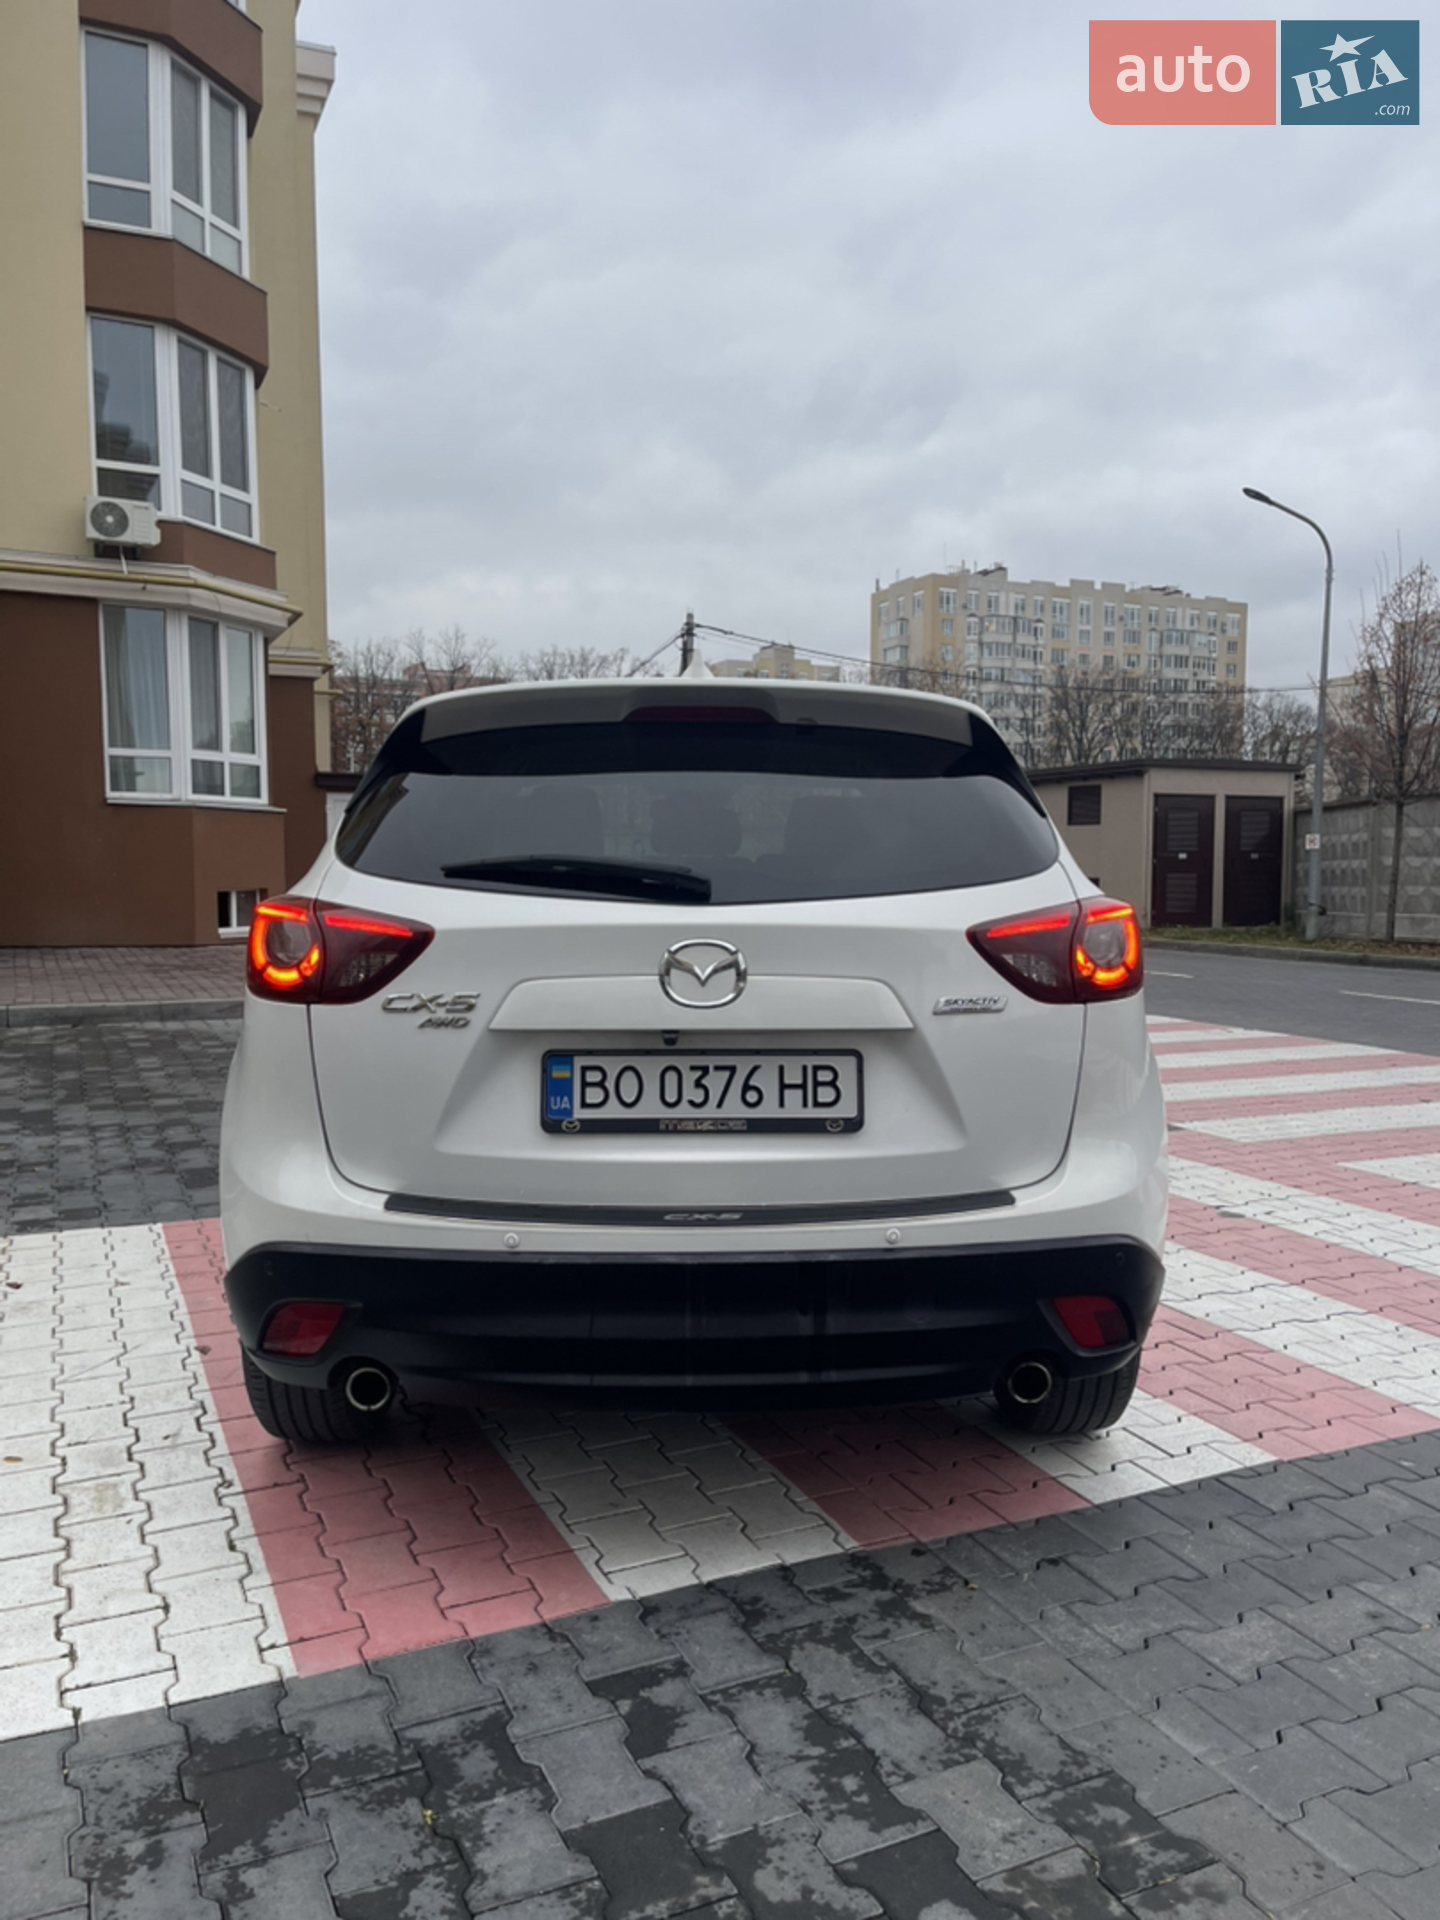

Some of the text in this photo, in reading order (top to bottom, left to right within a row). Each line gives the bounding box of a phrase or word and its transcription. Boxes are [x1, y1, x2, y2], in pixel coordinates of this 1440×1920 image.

[381, 992, 481, 1014] CX-5
[417, 1017, 471, 1029] AWD
[580, 1064, 842, 1109] BO 0376 HB
[550, 1096, 571, 1110] UA
